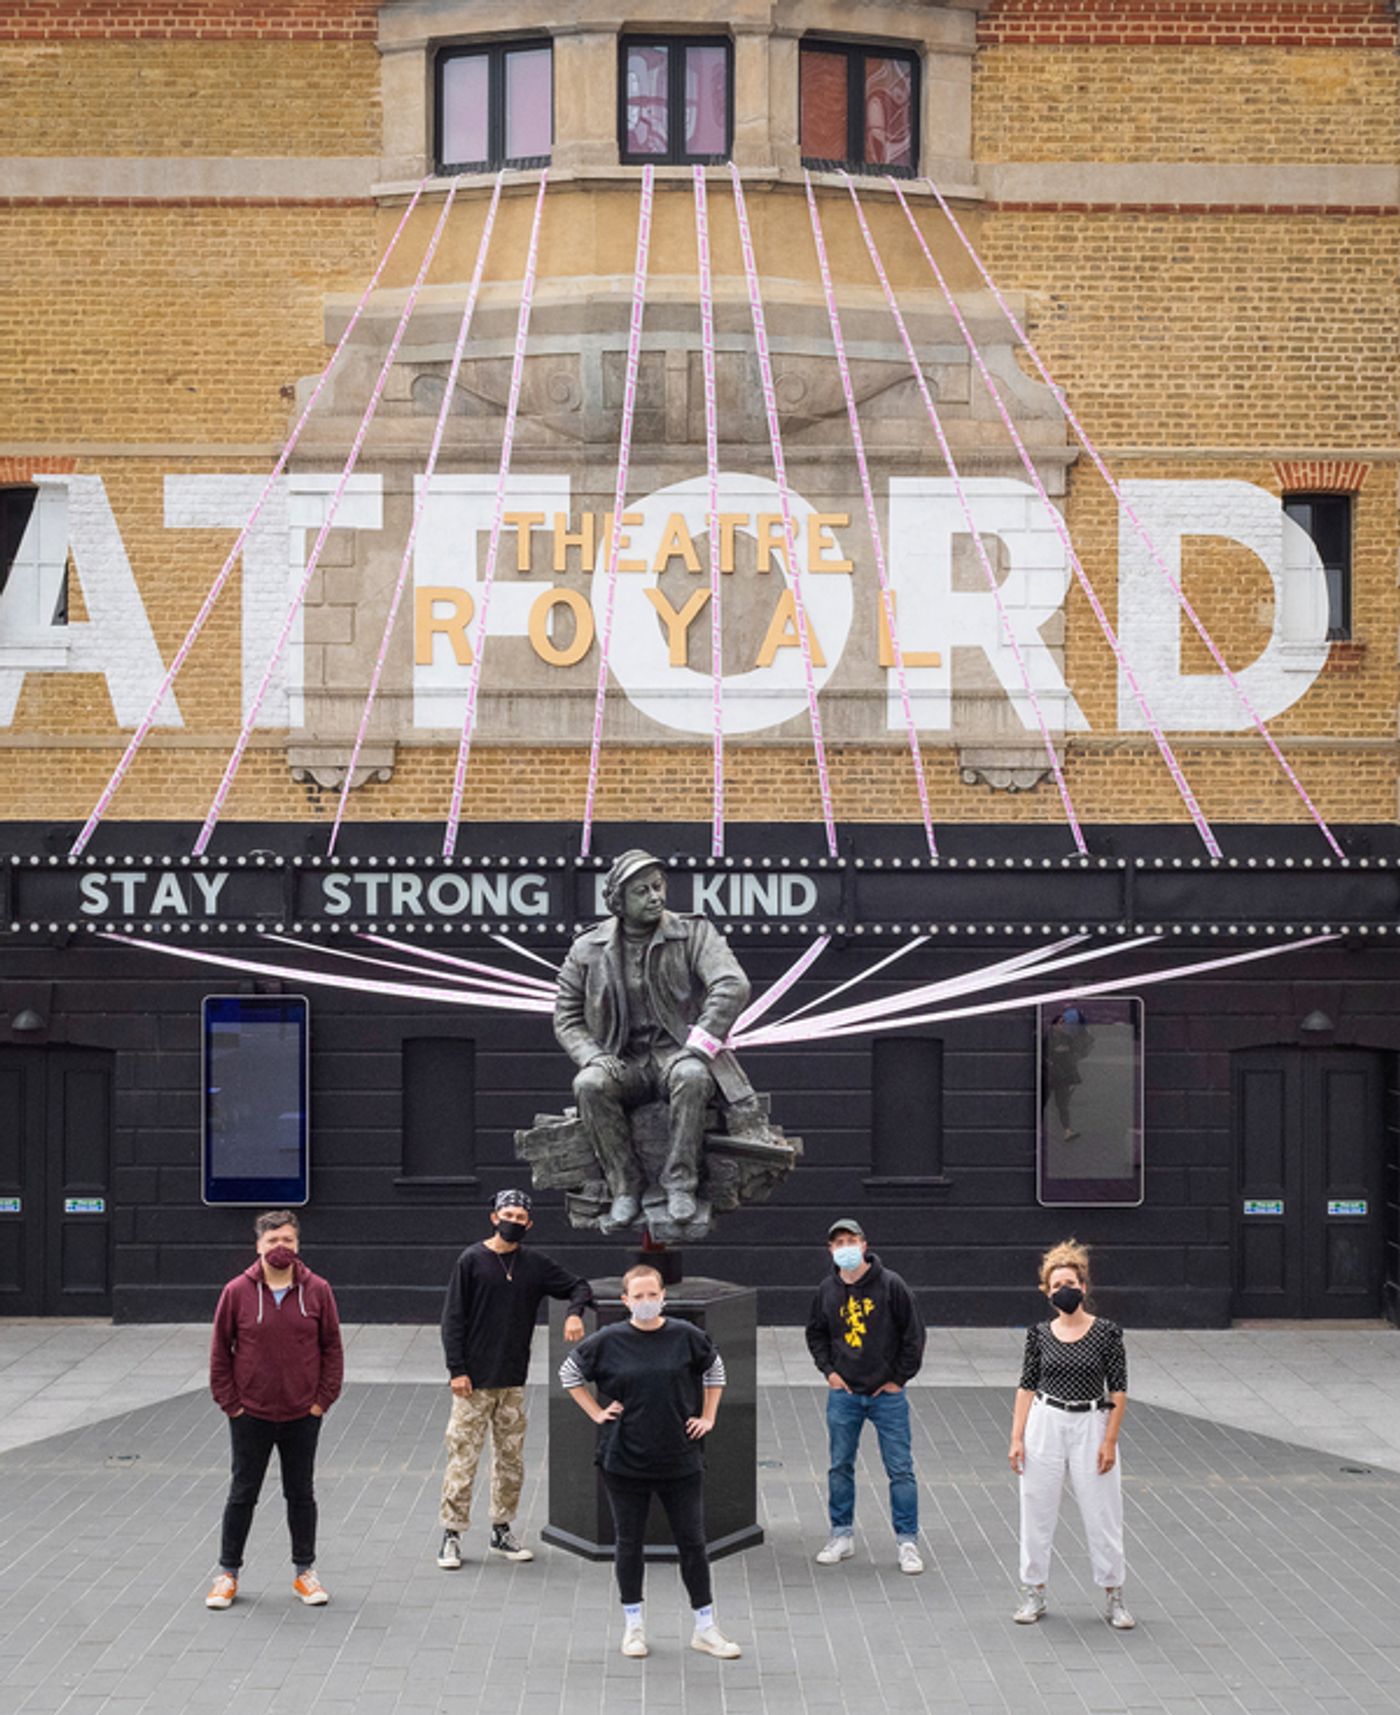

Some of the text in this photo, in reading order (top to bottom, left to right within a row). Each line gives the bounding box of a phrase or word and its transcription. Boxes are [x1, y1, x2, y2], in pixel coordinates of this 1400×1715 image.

[503, 512, 854, 574] THEATRE
[414, 586, 942, 668] ROYAL
[80, 873, 229, 916] STAY
[322, 873, 550, 917] STRONG
[693, 873, 818, 917] KIND
